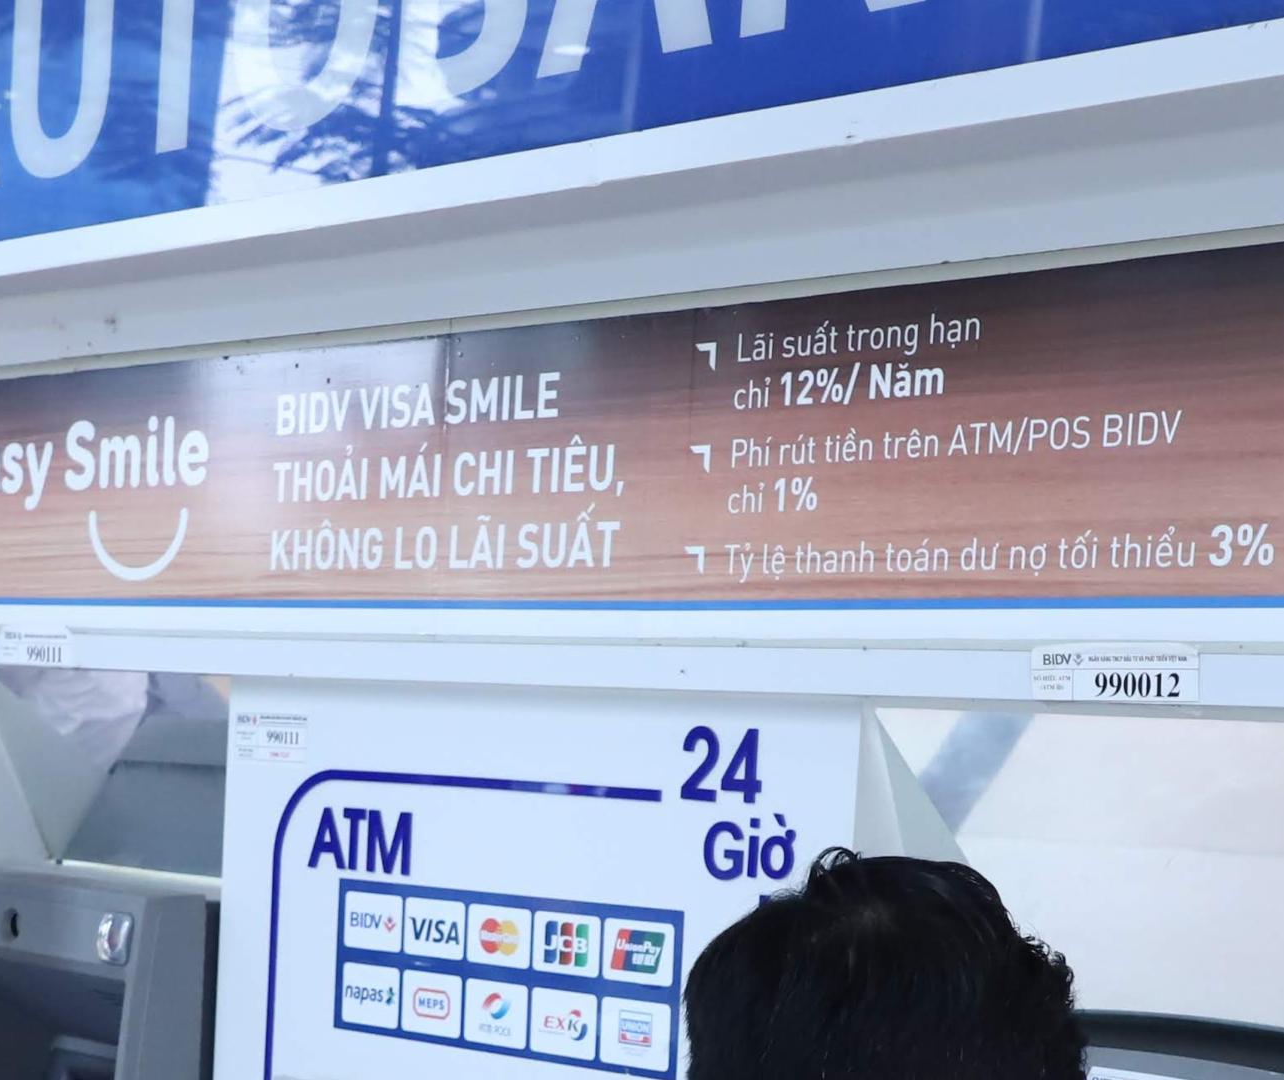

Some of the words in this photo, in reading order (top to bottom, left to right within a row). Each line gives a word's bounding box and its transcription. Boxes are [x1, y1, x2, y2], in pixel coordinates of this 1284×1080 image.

[737, 333, 774, 362] Lãi
[782, 321, 838, 358] suất
[847, 323, 919, 355] trong
[929, 313, 980, 349] hạn
[276, 388, 351, 437] BIDV
[360, 383, 436, 430] VISA
[445, 372, 561, 425] SMILE
[733, 377, 770, 410] chỉ
[780, 362, 861, 406] 12%/
[869, 362, 944, 400] Năm
[65, 415, 209, 491] Smile
[273, 445, 369, 503] THOẢI
[379, 442, 442, 499] MÁI
[453, 449, 515, 497] CHI
[527, 435, 625, 497] TIÊU,
[731, 436, 771, 469] Phí
[778, 434, 817, 465] rút
[823, 427, 873, 463] tiền
[883, 428, 940, 460] trên
[948, 416, 1091, 457] ATM/POS
[1102, 410, 1183, 448] BIDV
[727, 483, 765, 514] chỉ
[774, 476, 818, 513] 1%
[270, 518, 384, 571] KHÔNG
[394, 526, 438, 570] LO
[449, 515, 506, 570] LÃI
[517, 503, 621, 569] SUẤT
[724, 543, 755, 583] Tỷ
[763, 544, 786, 580] lệ
[795, 541, 875, 574] thanh
[885, 538, 949, 572] toán
[960, 538, 1000, 571] dư
[1009, 543, 1047, 577] nợ
[1059, 529, 1099, 569] tối
[1110, 526, 1195, 569] thiểu
[1209, 523, 1275, 568] 3%
[1042, 653, 1072, 666] BIDV
[1095, 672, 1180, 698] 990012
[681, 725, 763, 803] 24
[307, 806, 413, 876] ATM
[703, 814, 797, 881] Giờ
[350, 911, 382, 930] BIDV
[409, 916, 460, 945] VISA
[543, 930, 589, 957] JCB
[345, 984, 384, 1007] napas
[417, 996, 446, 1012] MEPS
